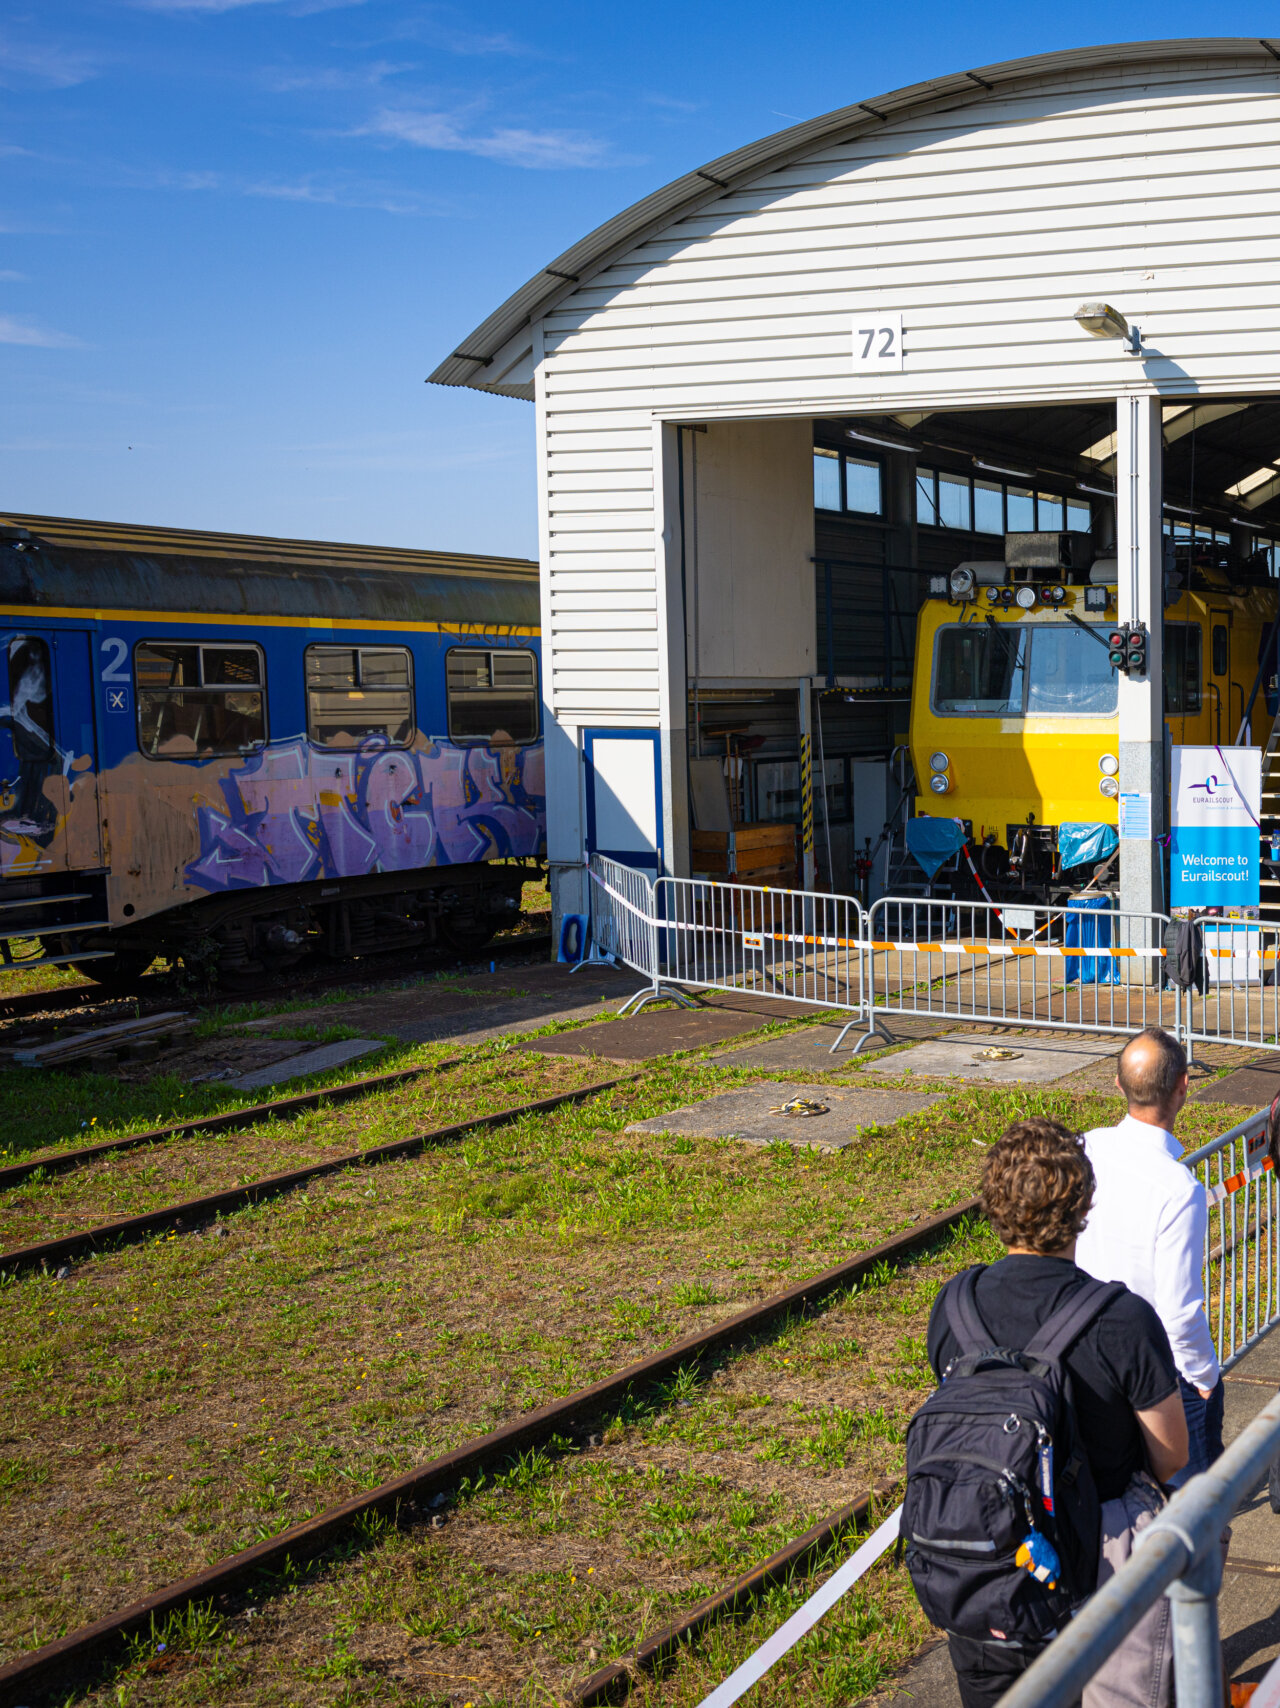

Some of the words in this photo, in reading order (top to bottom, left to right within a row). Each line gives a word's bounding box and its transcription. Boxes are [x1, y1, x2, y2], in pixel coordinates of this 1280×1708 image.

[858, 327, 896, 358] 72
[100, 637, 130, 682] 2
[1192, 796, 1234, 804] EURAILSCOUT
[1182, 854, 1235, 866] Welcome
[1237, 854, 1248, 866] to
[1181, 870, 1249, 882] Eurailscout!
